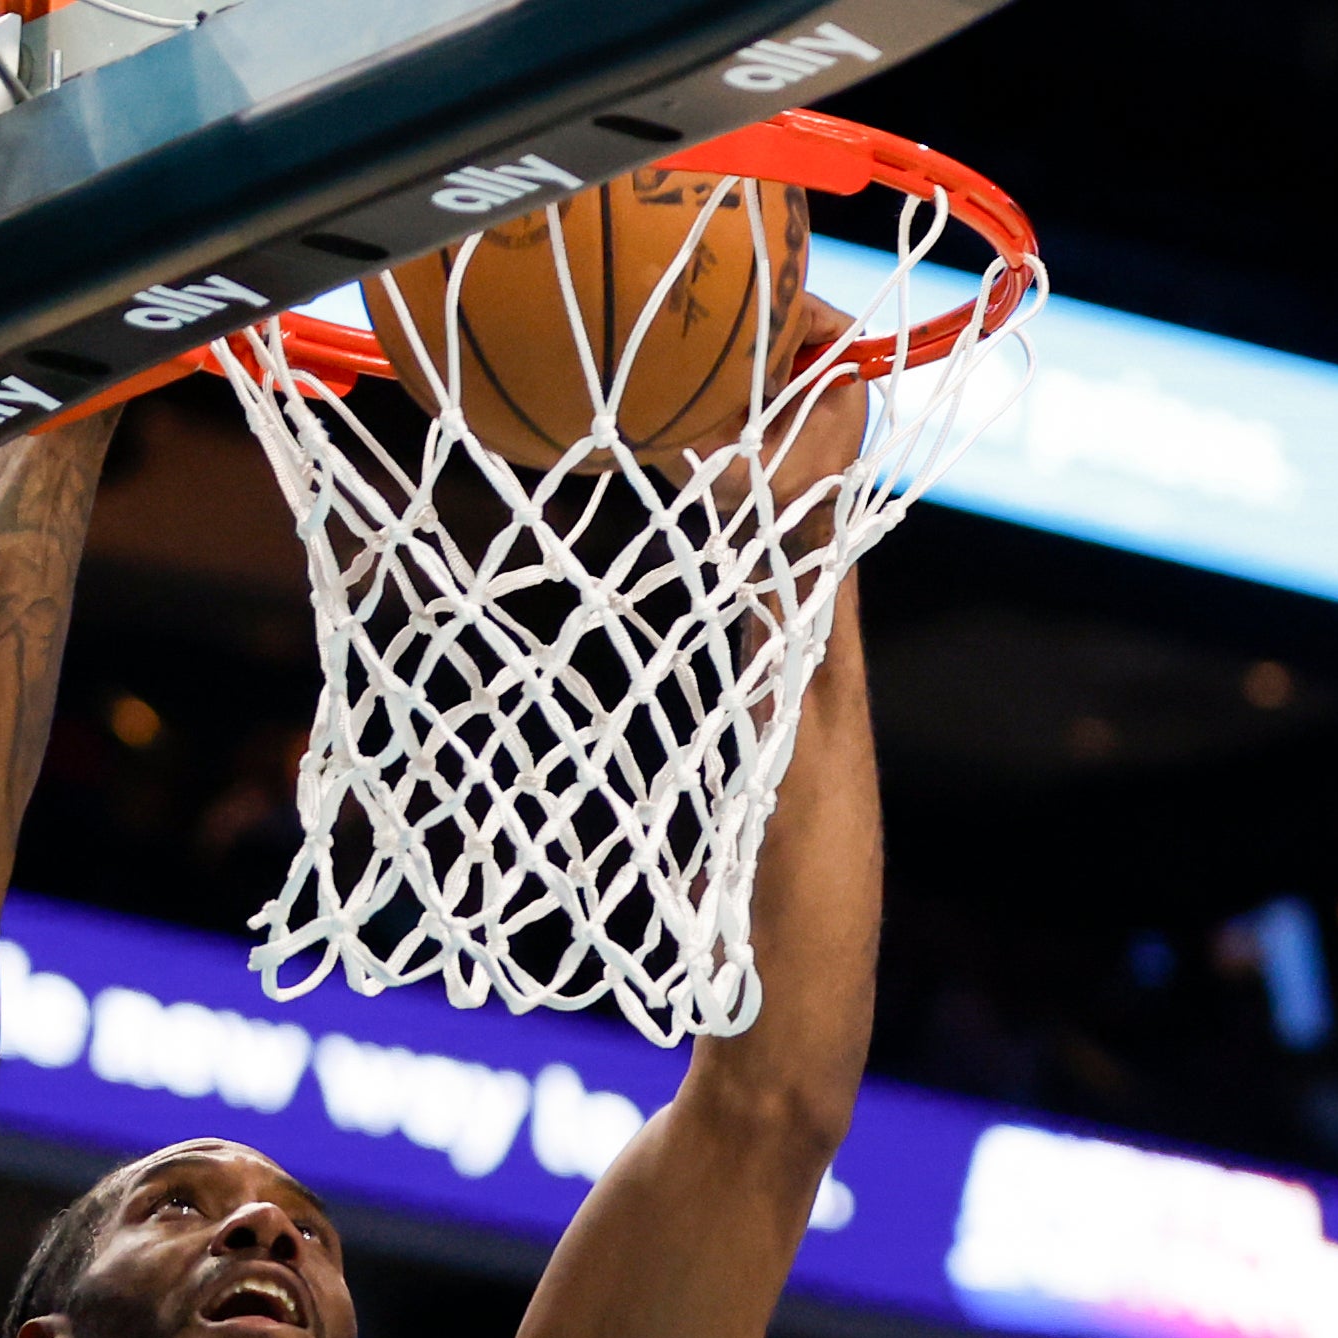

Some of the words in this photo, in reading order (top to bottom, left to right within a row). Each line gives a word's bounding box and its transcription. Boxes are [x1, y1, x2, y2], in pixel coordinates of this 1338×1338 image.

[722, 22, 882, 93] ally
[431, 153, 584, 214] ally
[123, 274, 270, 333] ally
